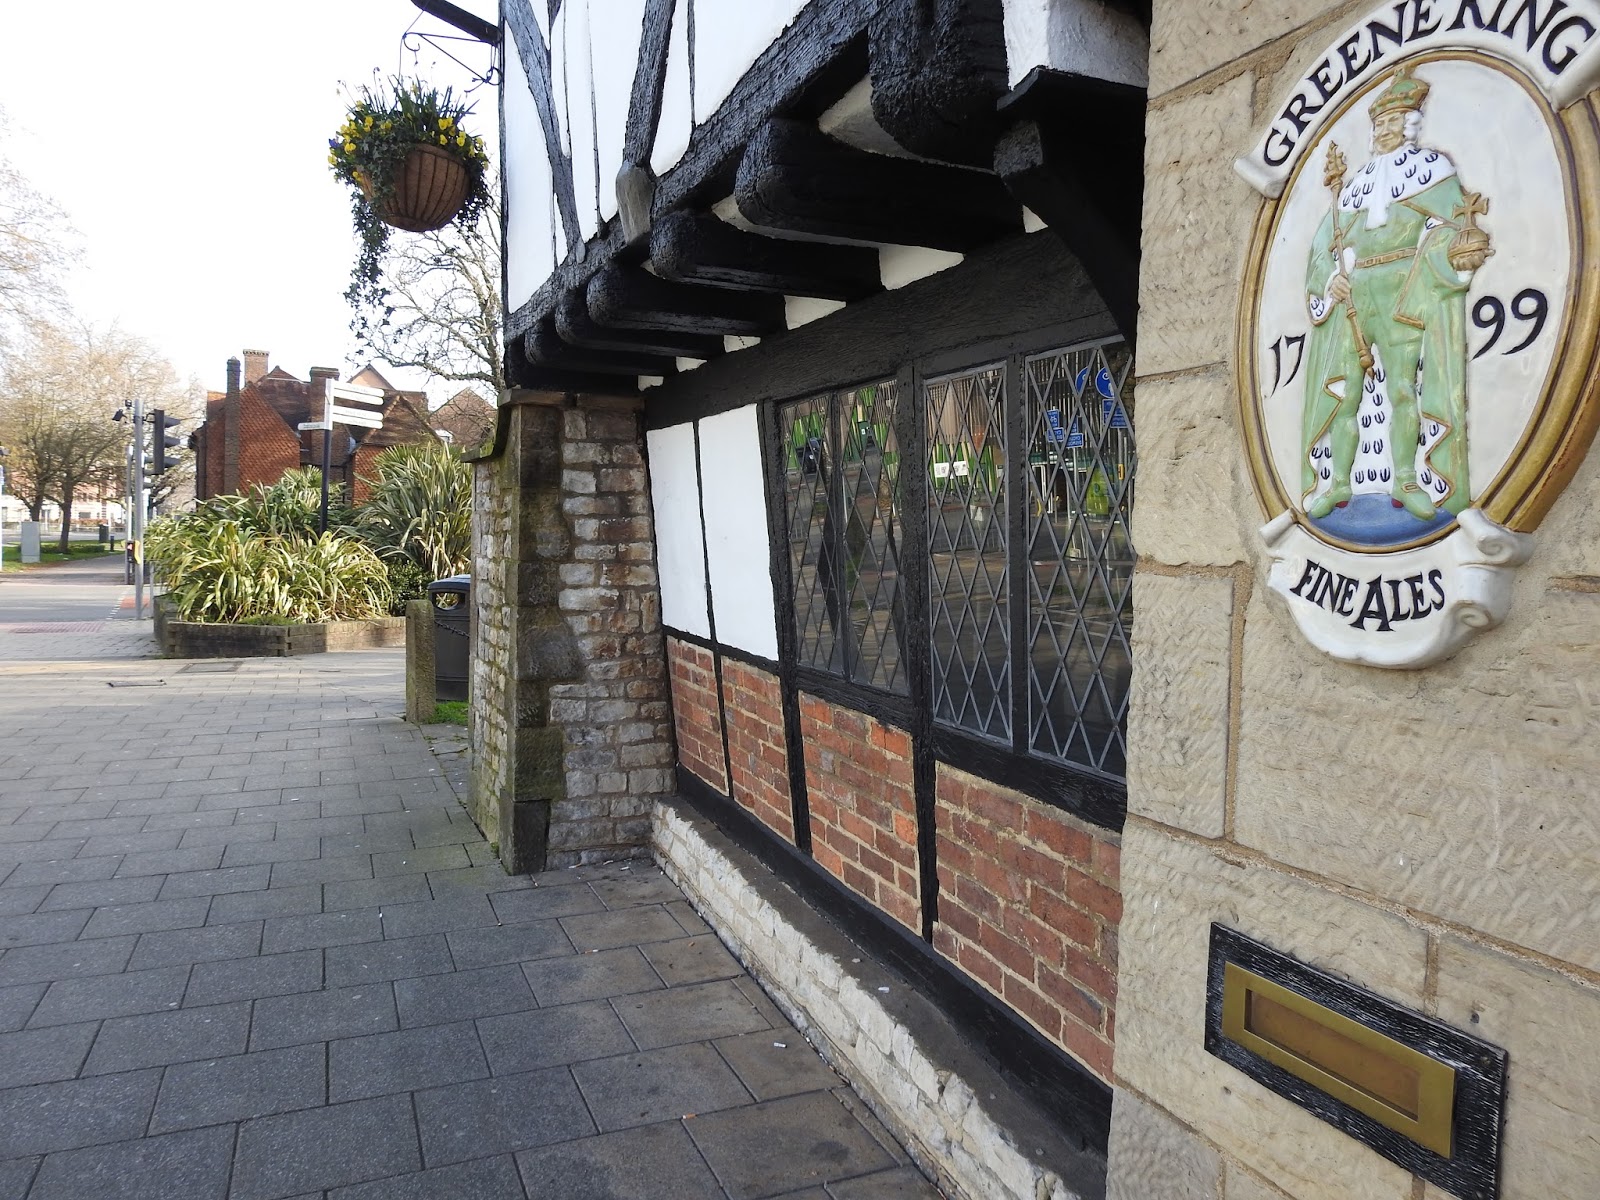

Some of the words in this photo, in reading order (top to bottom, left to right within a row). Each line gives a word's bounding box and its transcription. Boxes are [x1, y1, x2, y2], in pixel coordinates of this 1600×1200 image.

[1263, 0, 1443, 167] GREENE
[1445, 0, 1597, 76] KING
[1269, 332, 1307, 398] 17
[1470, 287, 1549, 362] 99
[1289, 559, 1362, 617] FINE
[1348, 568, 1445, 632] ALES
